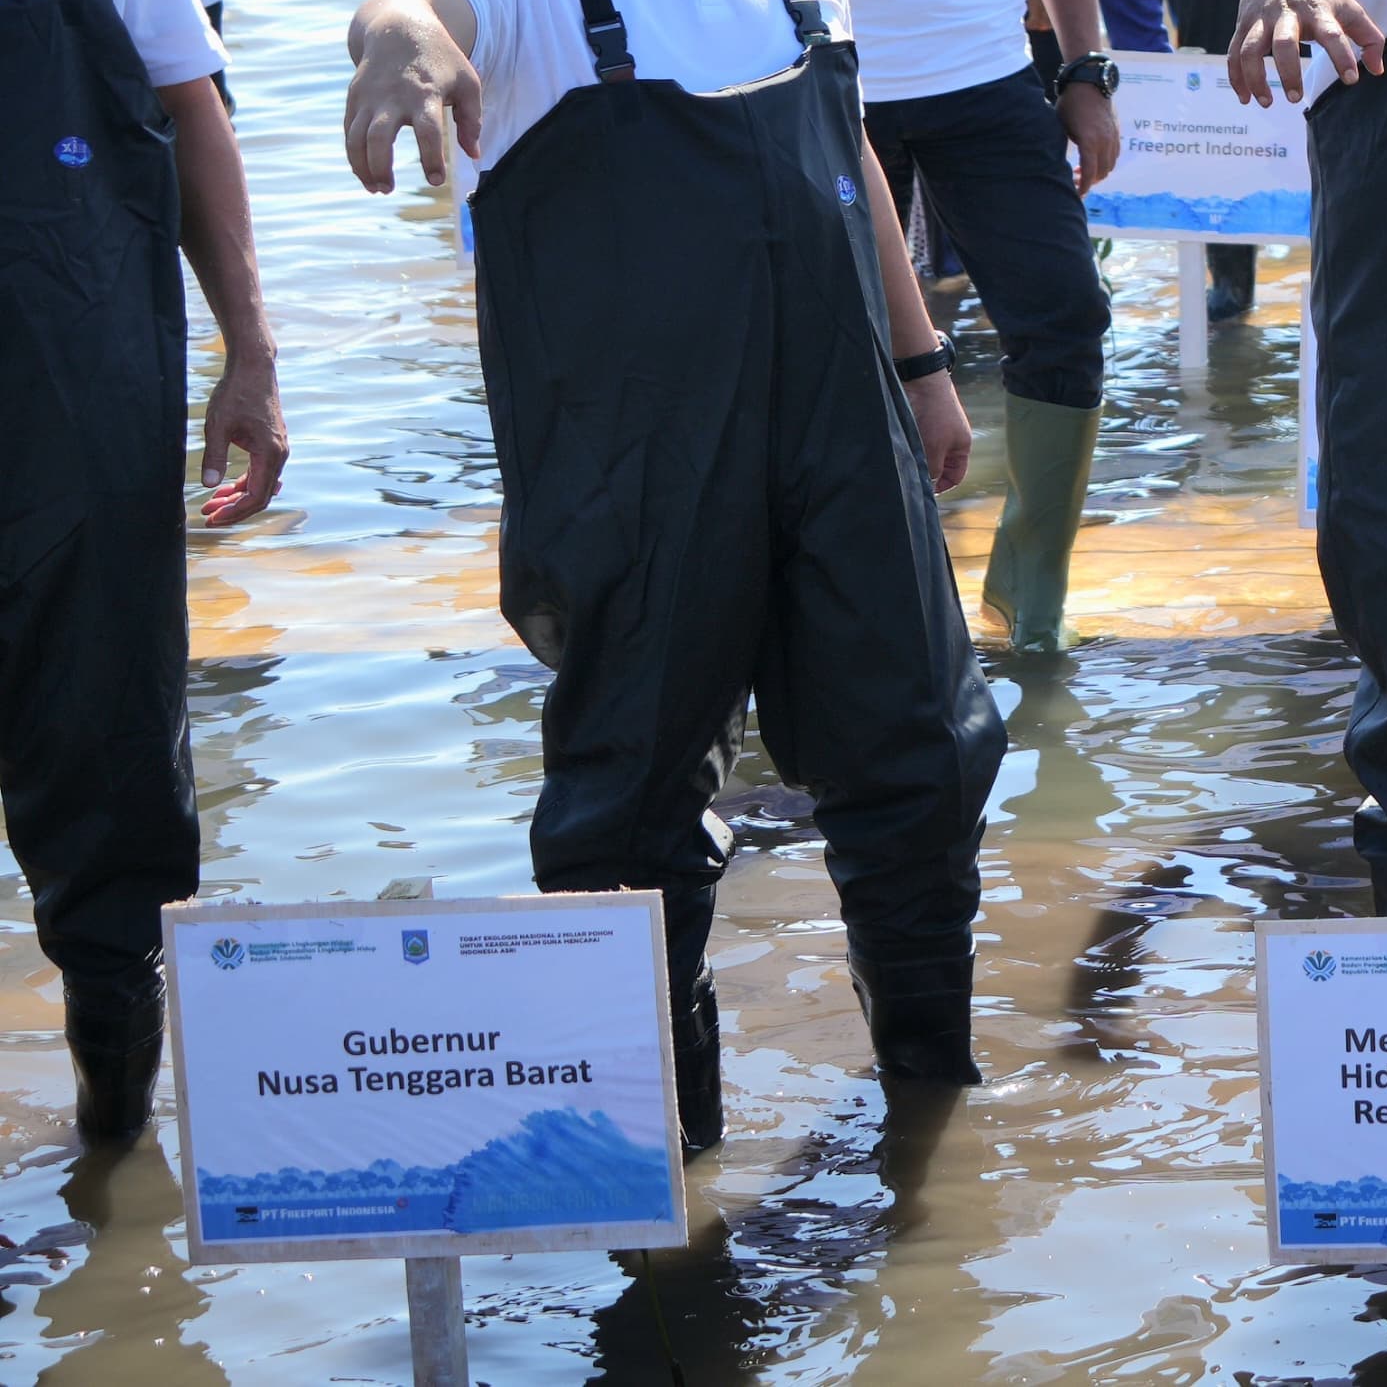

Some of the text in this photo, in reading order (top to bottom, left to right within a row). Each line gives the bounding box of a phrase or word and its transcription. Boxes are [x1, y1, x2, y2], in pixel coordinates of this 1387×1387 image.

[1134, 118, 1248, 136] VP Environmental
[1129, 137, 1288, 159] Freeport Indonesia
[343, 1028, 501, 1056] Gubernur
[258, 1060, 593, 1096] Nusa Tenggara Barat
[261, 1205, 396, 1220] PT FREEPORT INDONESIA
[1340, 1216, 1358, 1227] PT
